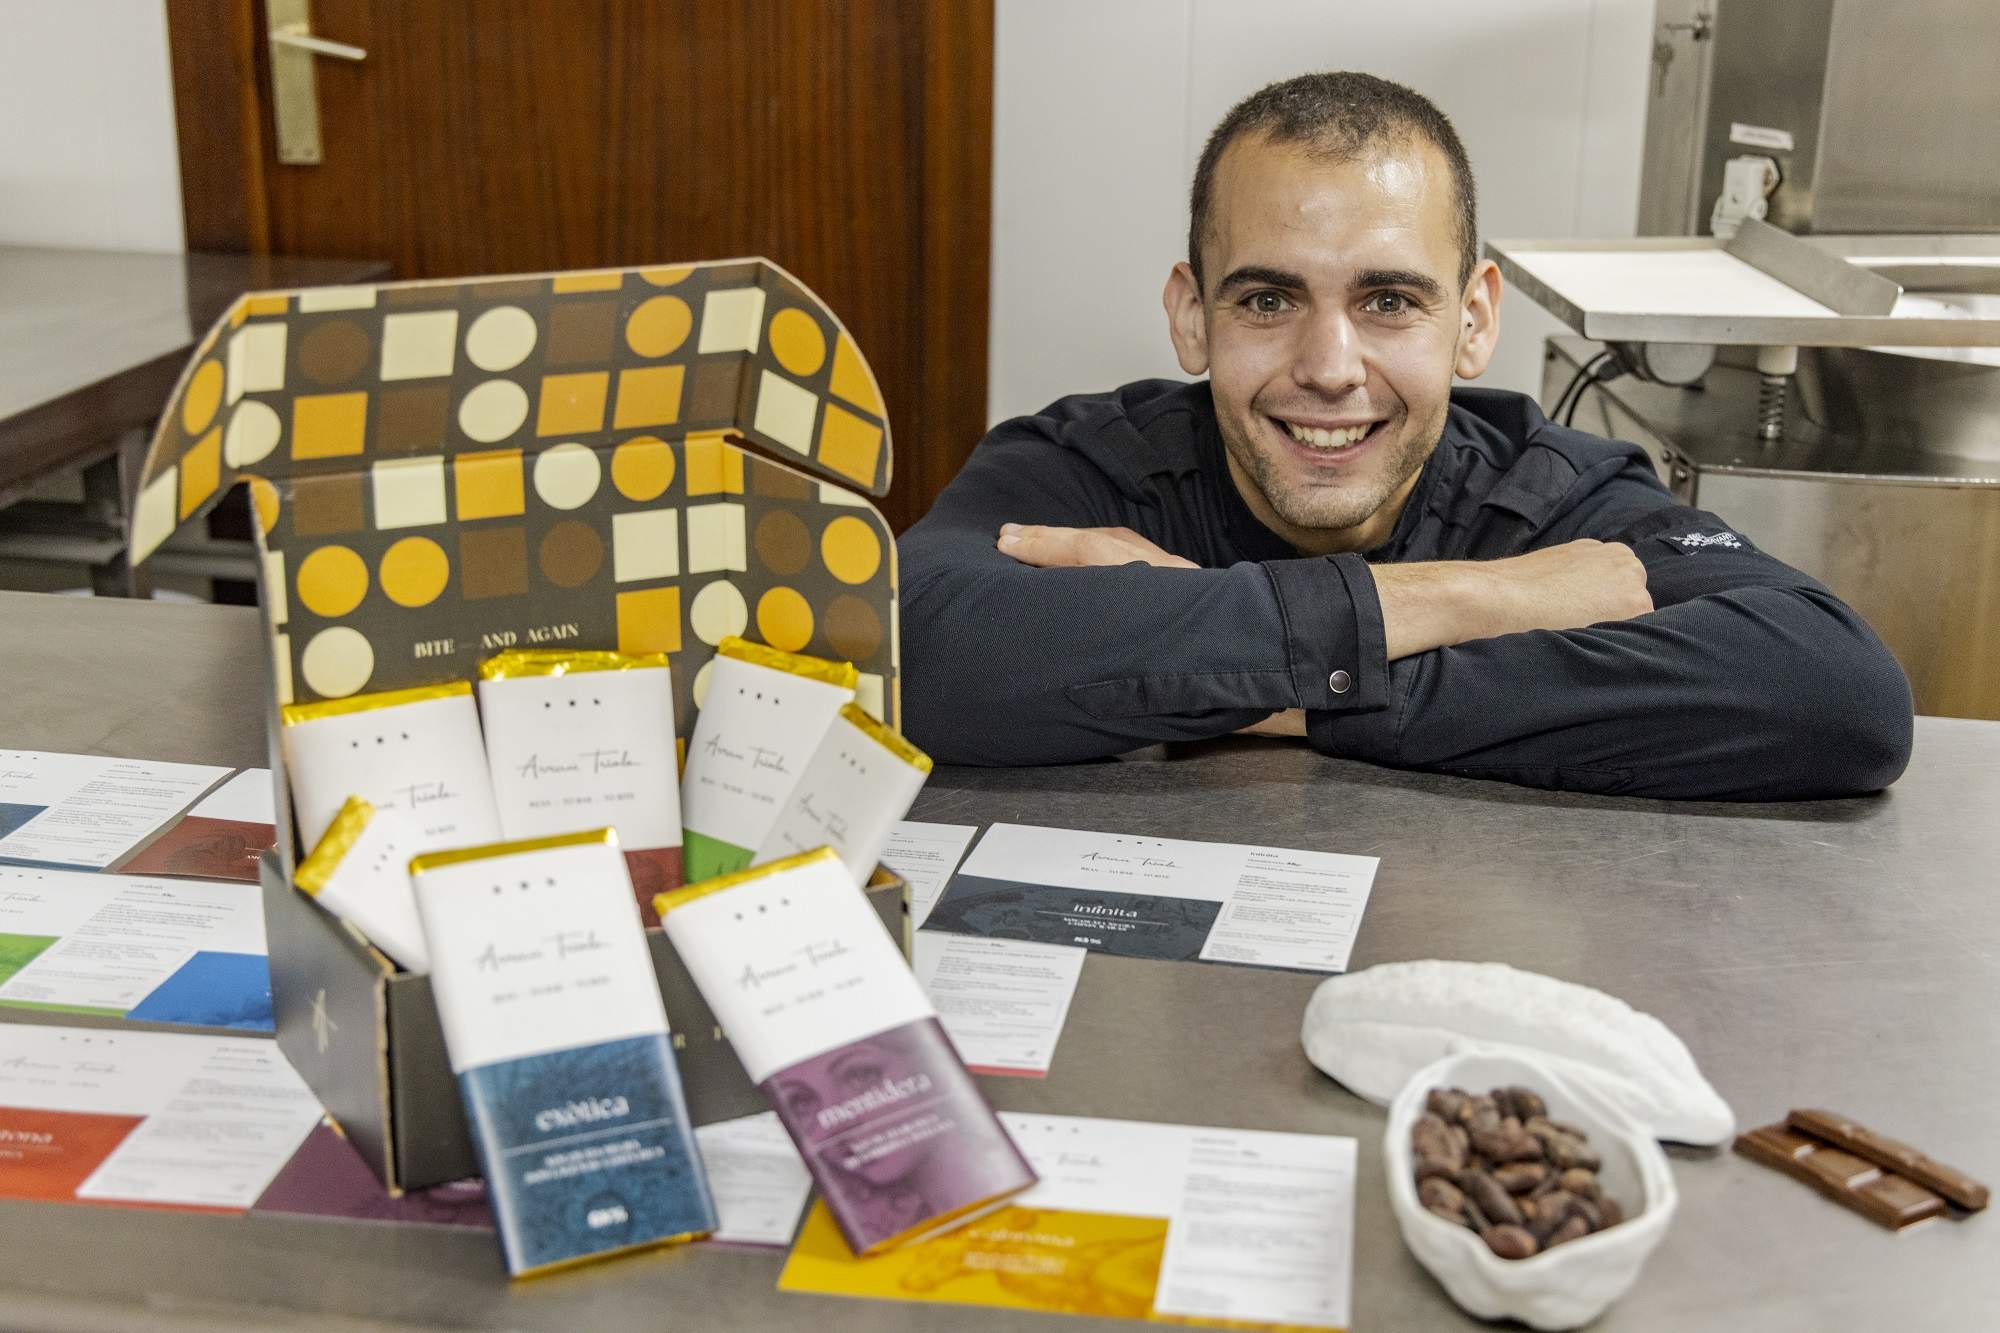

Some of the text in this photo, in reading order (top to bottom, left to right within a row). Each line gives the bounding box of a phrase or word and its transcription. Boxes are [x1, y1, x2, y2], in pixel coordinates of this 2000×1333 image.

[414, 622, 579, 659] BITE AND AGAIN
